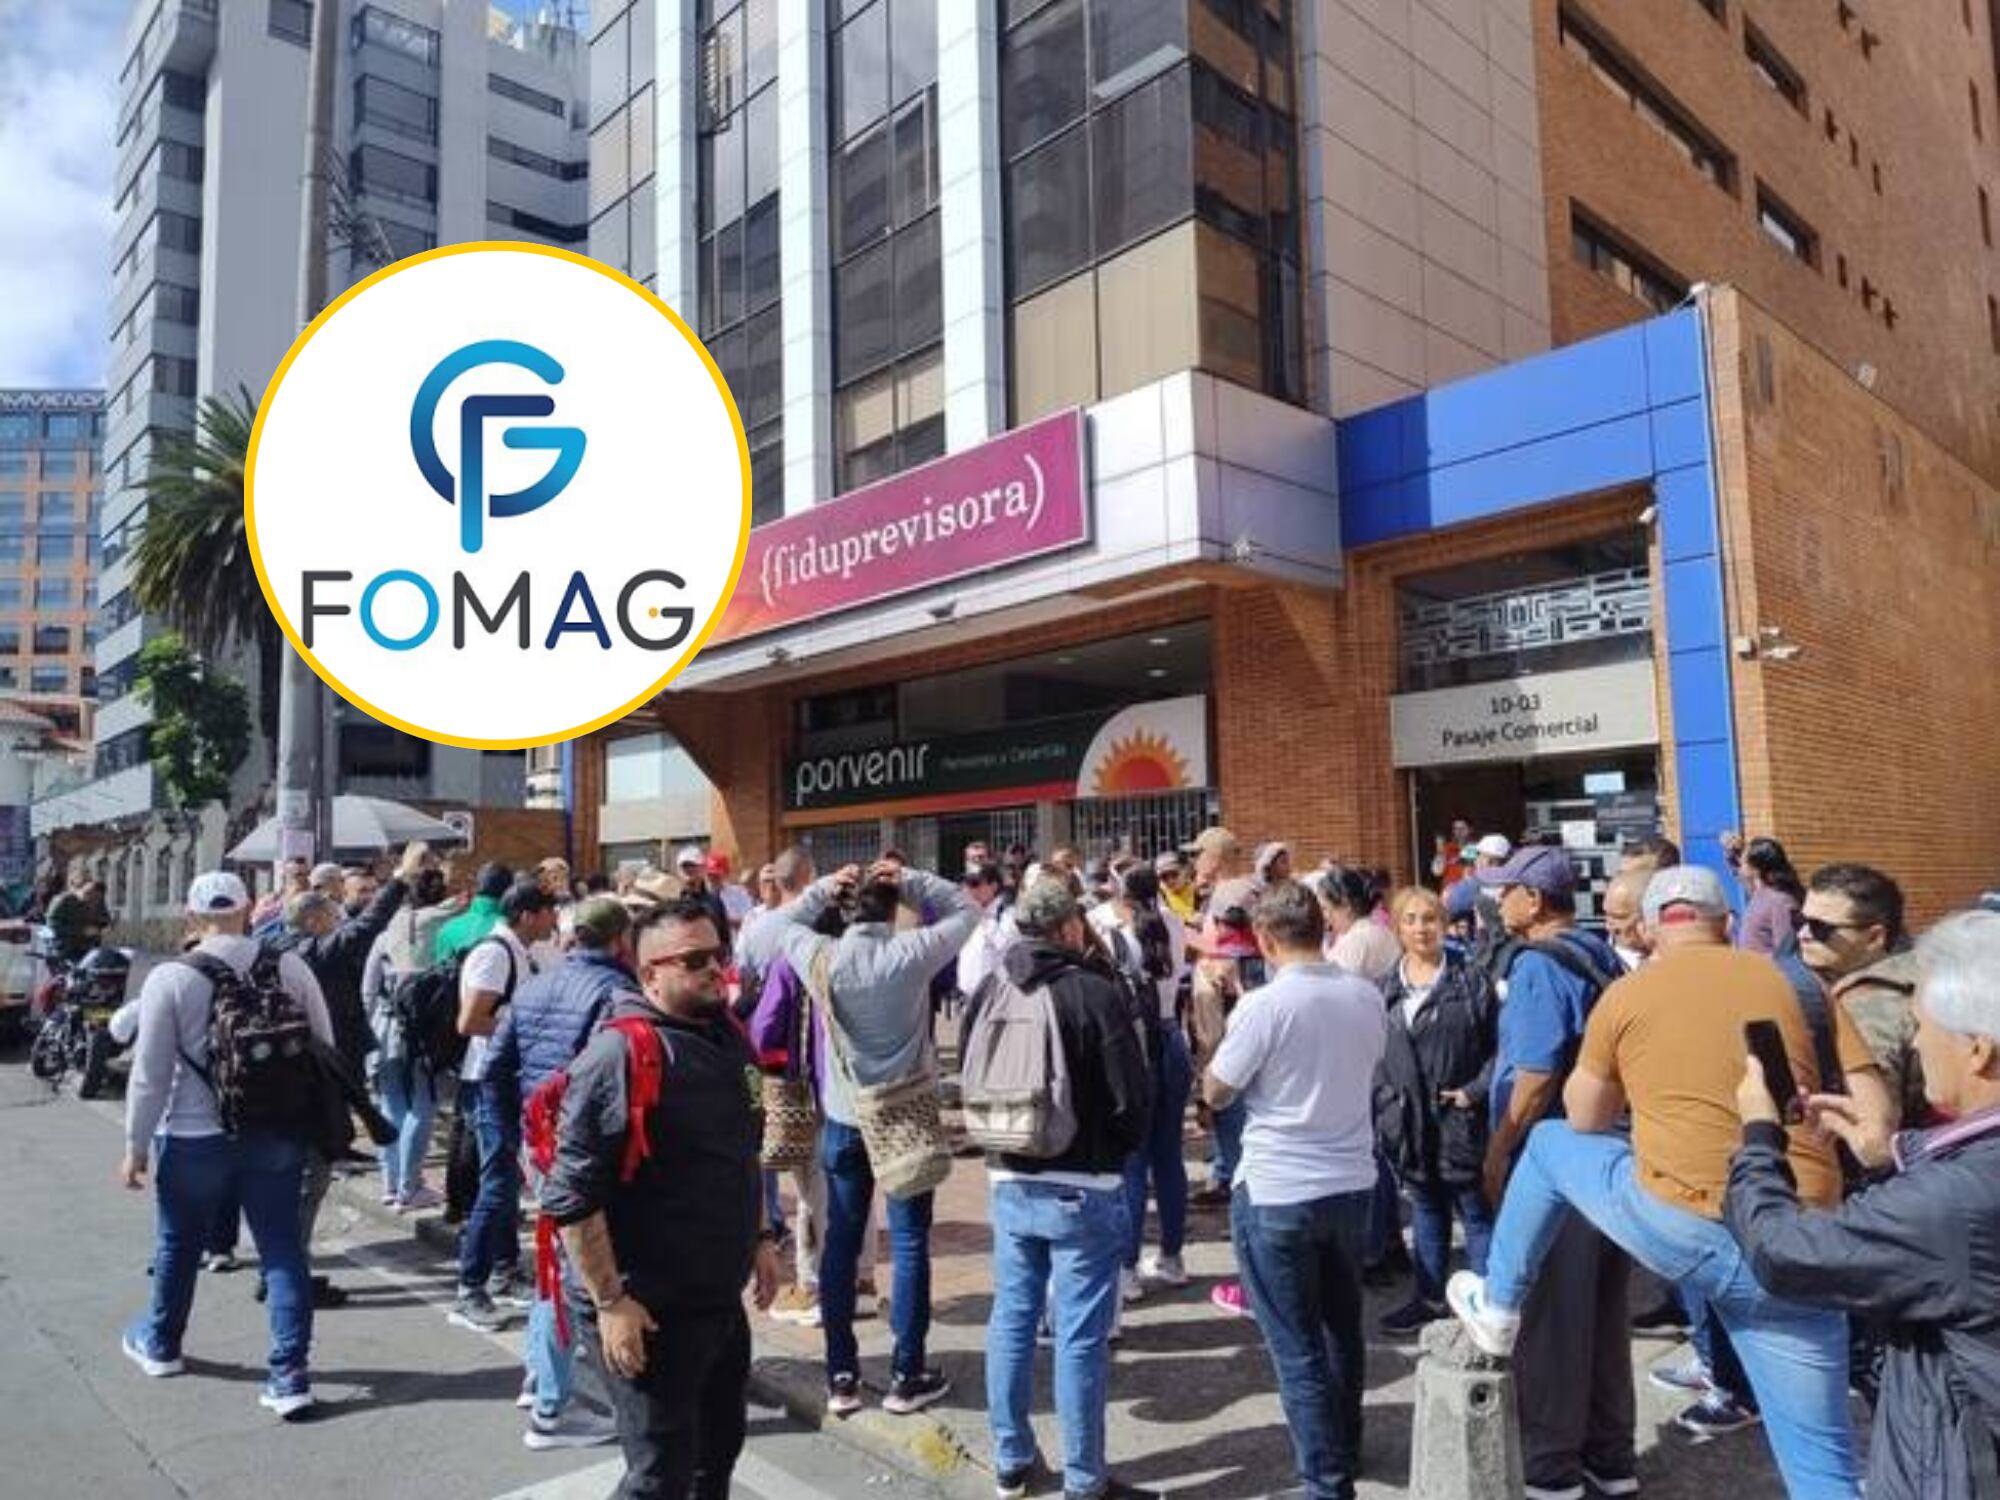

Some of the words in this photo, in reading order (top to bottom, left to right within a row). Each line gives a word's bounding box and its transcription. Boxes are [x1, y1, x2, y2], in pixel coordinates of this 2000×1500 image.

[1491, 694, 1541, 714] 10-03
[1442, 726, 1497, 748] Pasaje
[1501, 712, 1599, 742] Comercial
[796, 744, 929, 807] porvenir
